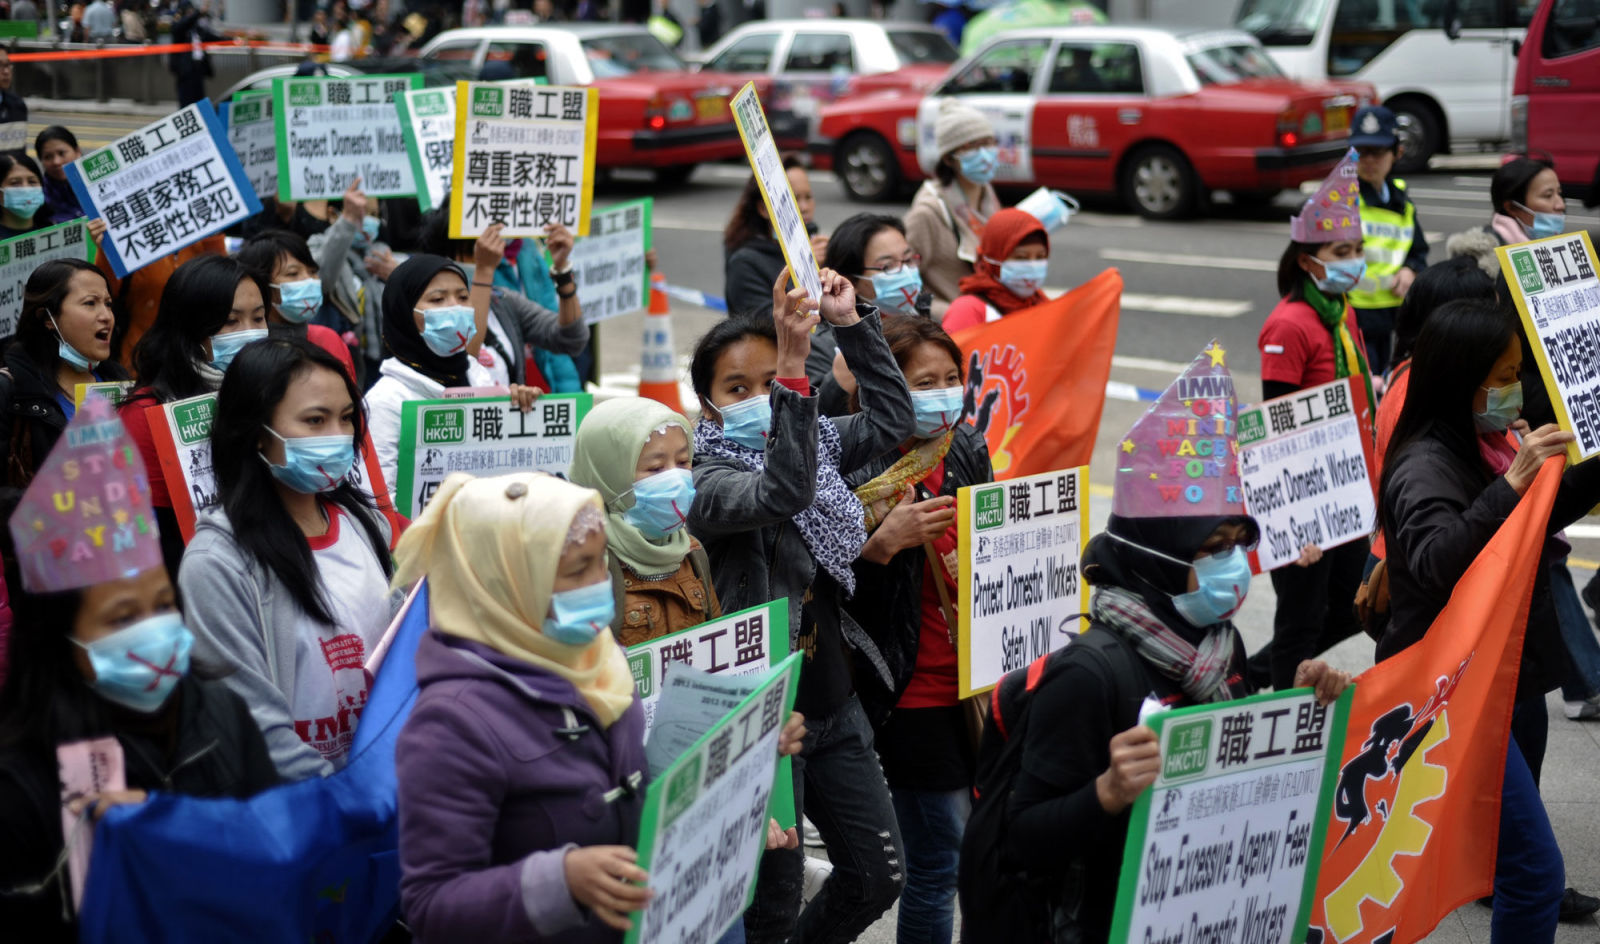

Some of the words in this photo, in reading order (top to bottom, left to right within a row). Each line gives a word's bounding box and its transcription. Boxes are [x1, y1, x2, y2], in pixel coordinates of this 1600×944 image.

[474, 102, 501, 115] HKCTU
[509, 88, 583, 121] 職工盟
[117, 109, 202, 163] 職工盟
[290, 130, 328, 160] Respect
[331, 127, 373, 156] Domestic
[376, 127, 406, 154] Worke
[87, 160, 118, 179] HKCTU
[303, 165, 325, 195] Stop
[361, 162, 401, 191] Violence
[466, 149, 578, 188] 尊重家務工
[103, 157, 225, 230] 尊重家務工
[465, 192, 576, 228] 不要性侵犯
[15, 223, 83, 259] 職工盟
[117, 187, 240, 260] 不要性侵犯
[1534, 239, 1594, 288] 職工盟
[183, 403, 212, 423] 工盟
[433, 412, 457, 427] 工盟
[472, 404, 571, 442] 職工盟
[1268, 384, 1350, 435] 職工盟
[181, 420, 214, 440] HKCT
[426, 427, 462, 441] HKCTU
[1156, 439, 1228, 457] WAGE
[1170, 460, 1220, 478] FOR
[1244, 472, 1286, 519] Respect
[1283, 458, 1328, 503] Domestic
[1325, 449, 1366, 489] Workers
[981, 492, 999, 509] 工盟
[1009, 473, 1077, 523] 職工盟
[976, 508, 1003, 526] HKCTU
[1266, 524, 1292, 561] Stop
[1289, 508, 1323, 550] Sexual
[1321, 500, 1362, 540] Violence
[973, 572, 1004, 619] Protect
[1007, 557, 1043, 611] Domestic
[1046, 553, 1077, 601] Workers
[1001, 624, 1028, 673] Safety
[1030, 616, 1052, 661] NOW
[703, 676, 785, 790] 職工盟
[1176, 726, 1204, 750] 工盟
[1216, 700, 1327, 769] 職工盟
[1166, 748, 1208, 774] HKCTU
[1141, 841, 1172, 913] Stop
[1173, 824, 1233, 897] Excessive
[1234, 819, 1281, 888] Agency
[1281, 809, 1310, 869] Fees
[1240, 891, 1287, 944] Workers
